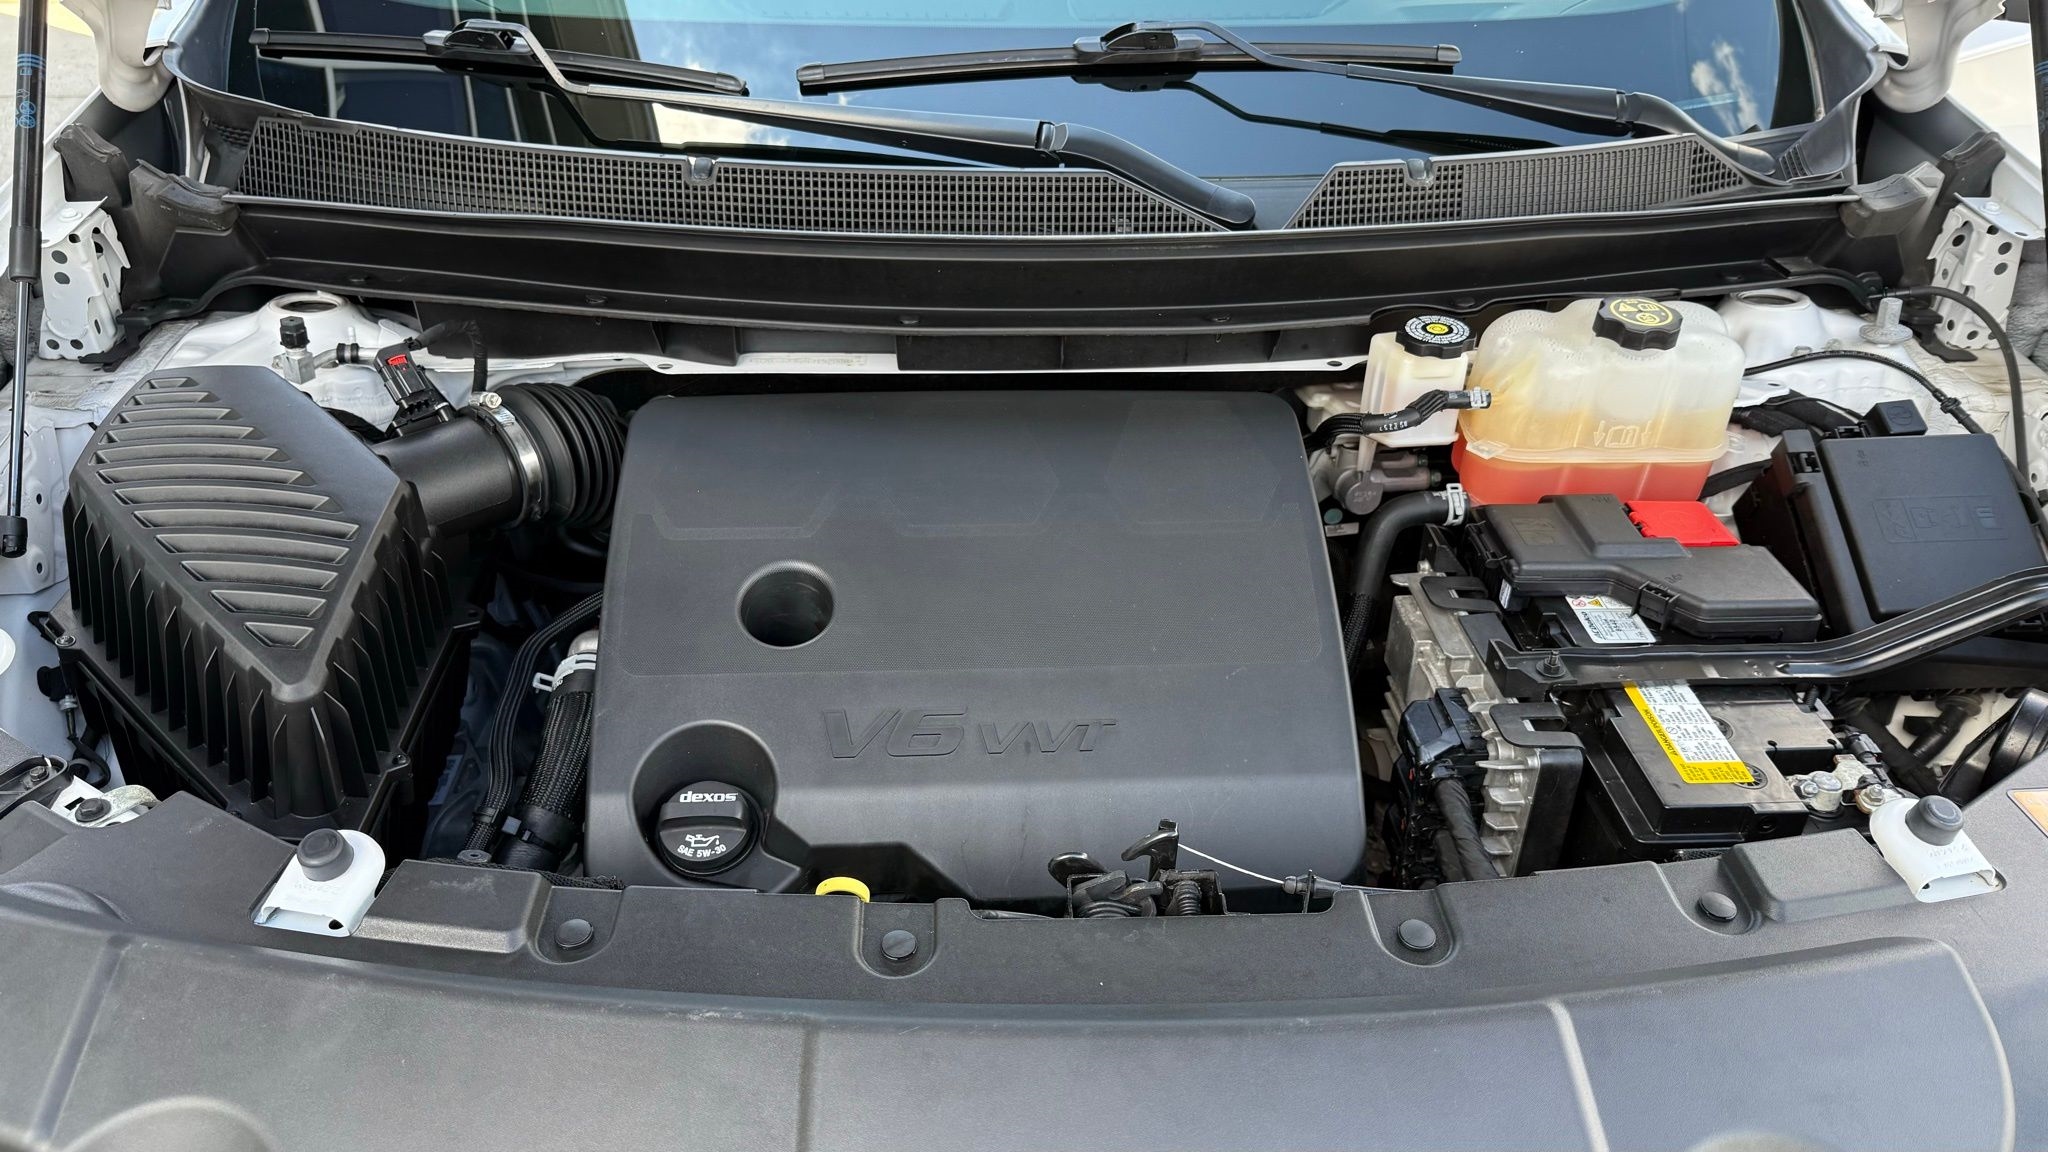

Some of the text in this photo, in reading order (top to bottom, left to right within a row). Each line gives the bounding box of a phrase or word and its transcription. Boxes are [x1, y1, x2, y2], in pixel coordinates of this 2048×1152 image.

[822, 706, 1117, 758] V6 VVT
[680, 790, 738, 803] dexos
[677, 844, 727, 858] SAE 5W-30
